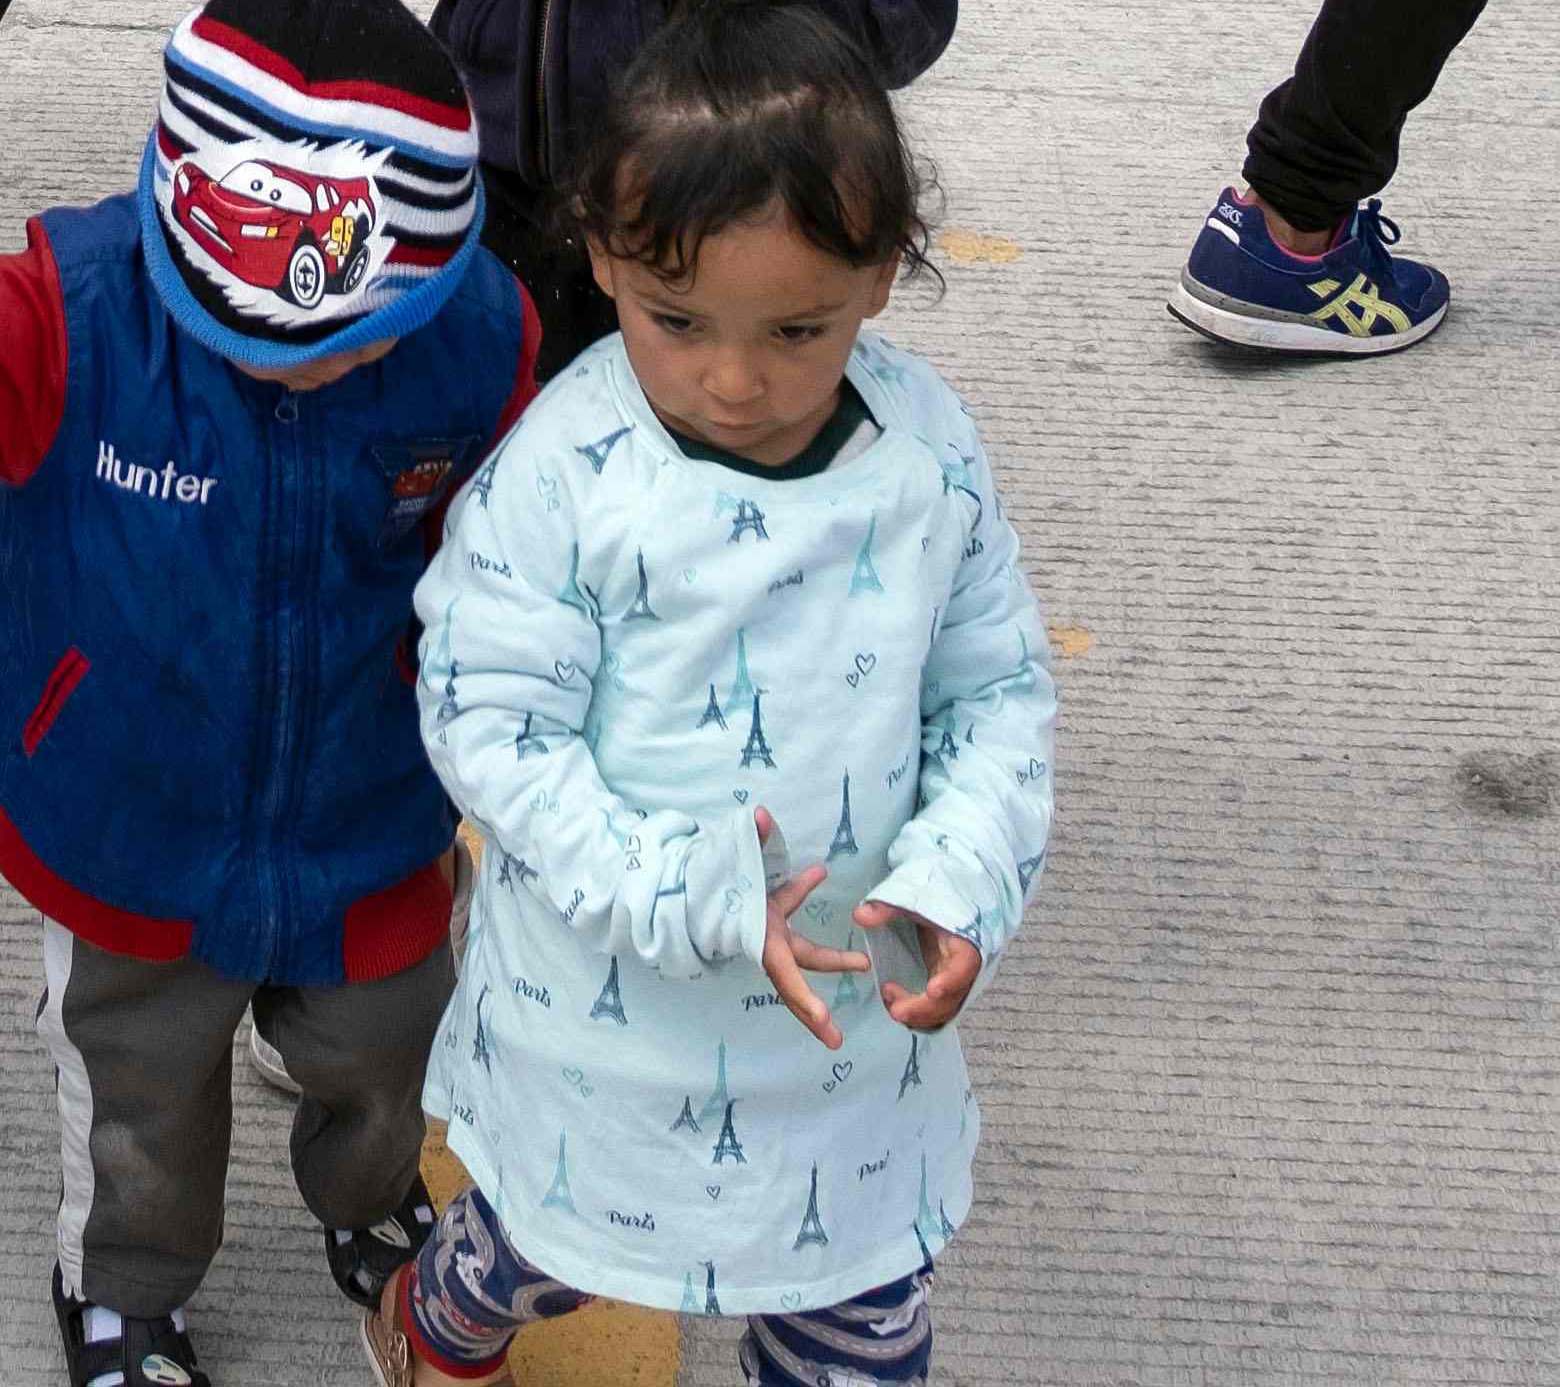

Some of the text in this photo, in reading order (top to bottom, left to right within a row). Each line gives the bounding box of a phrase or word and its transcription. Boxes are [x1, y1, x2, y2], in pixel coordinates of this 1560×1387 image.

[95, 439, 219, 506] Hunter
[511, 976, 553, 1009] Paris
[608, 1209, 656, 1233] Paris
